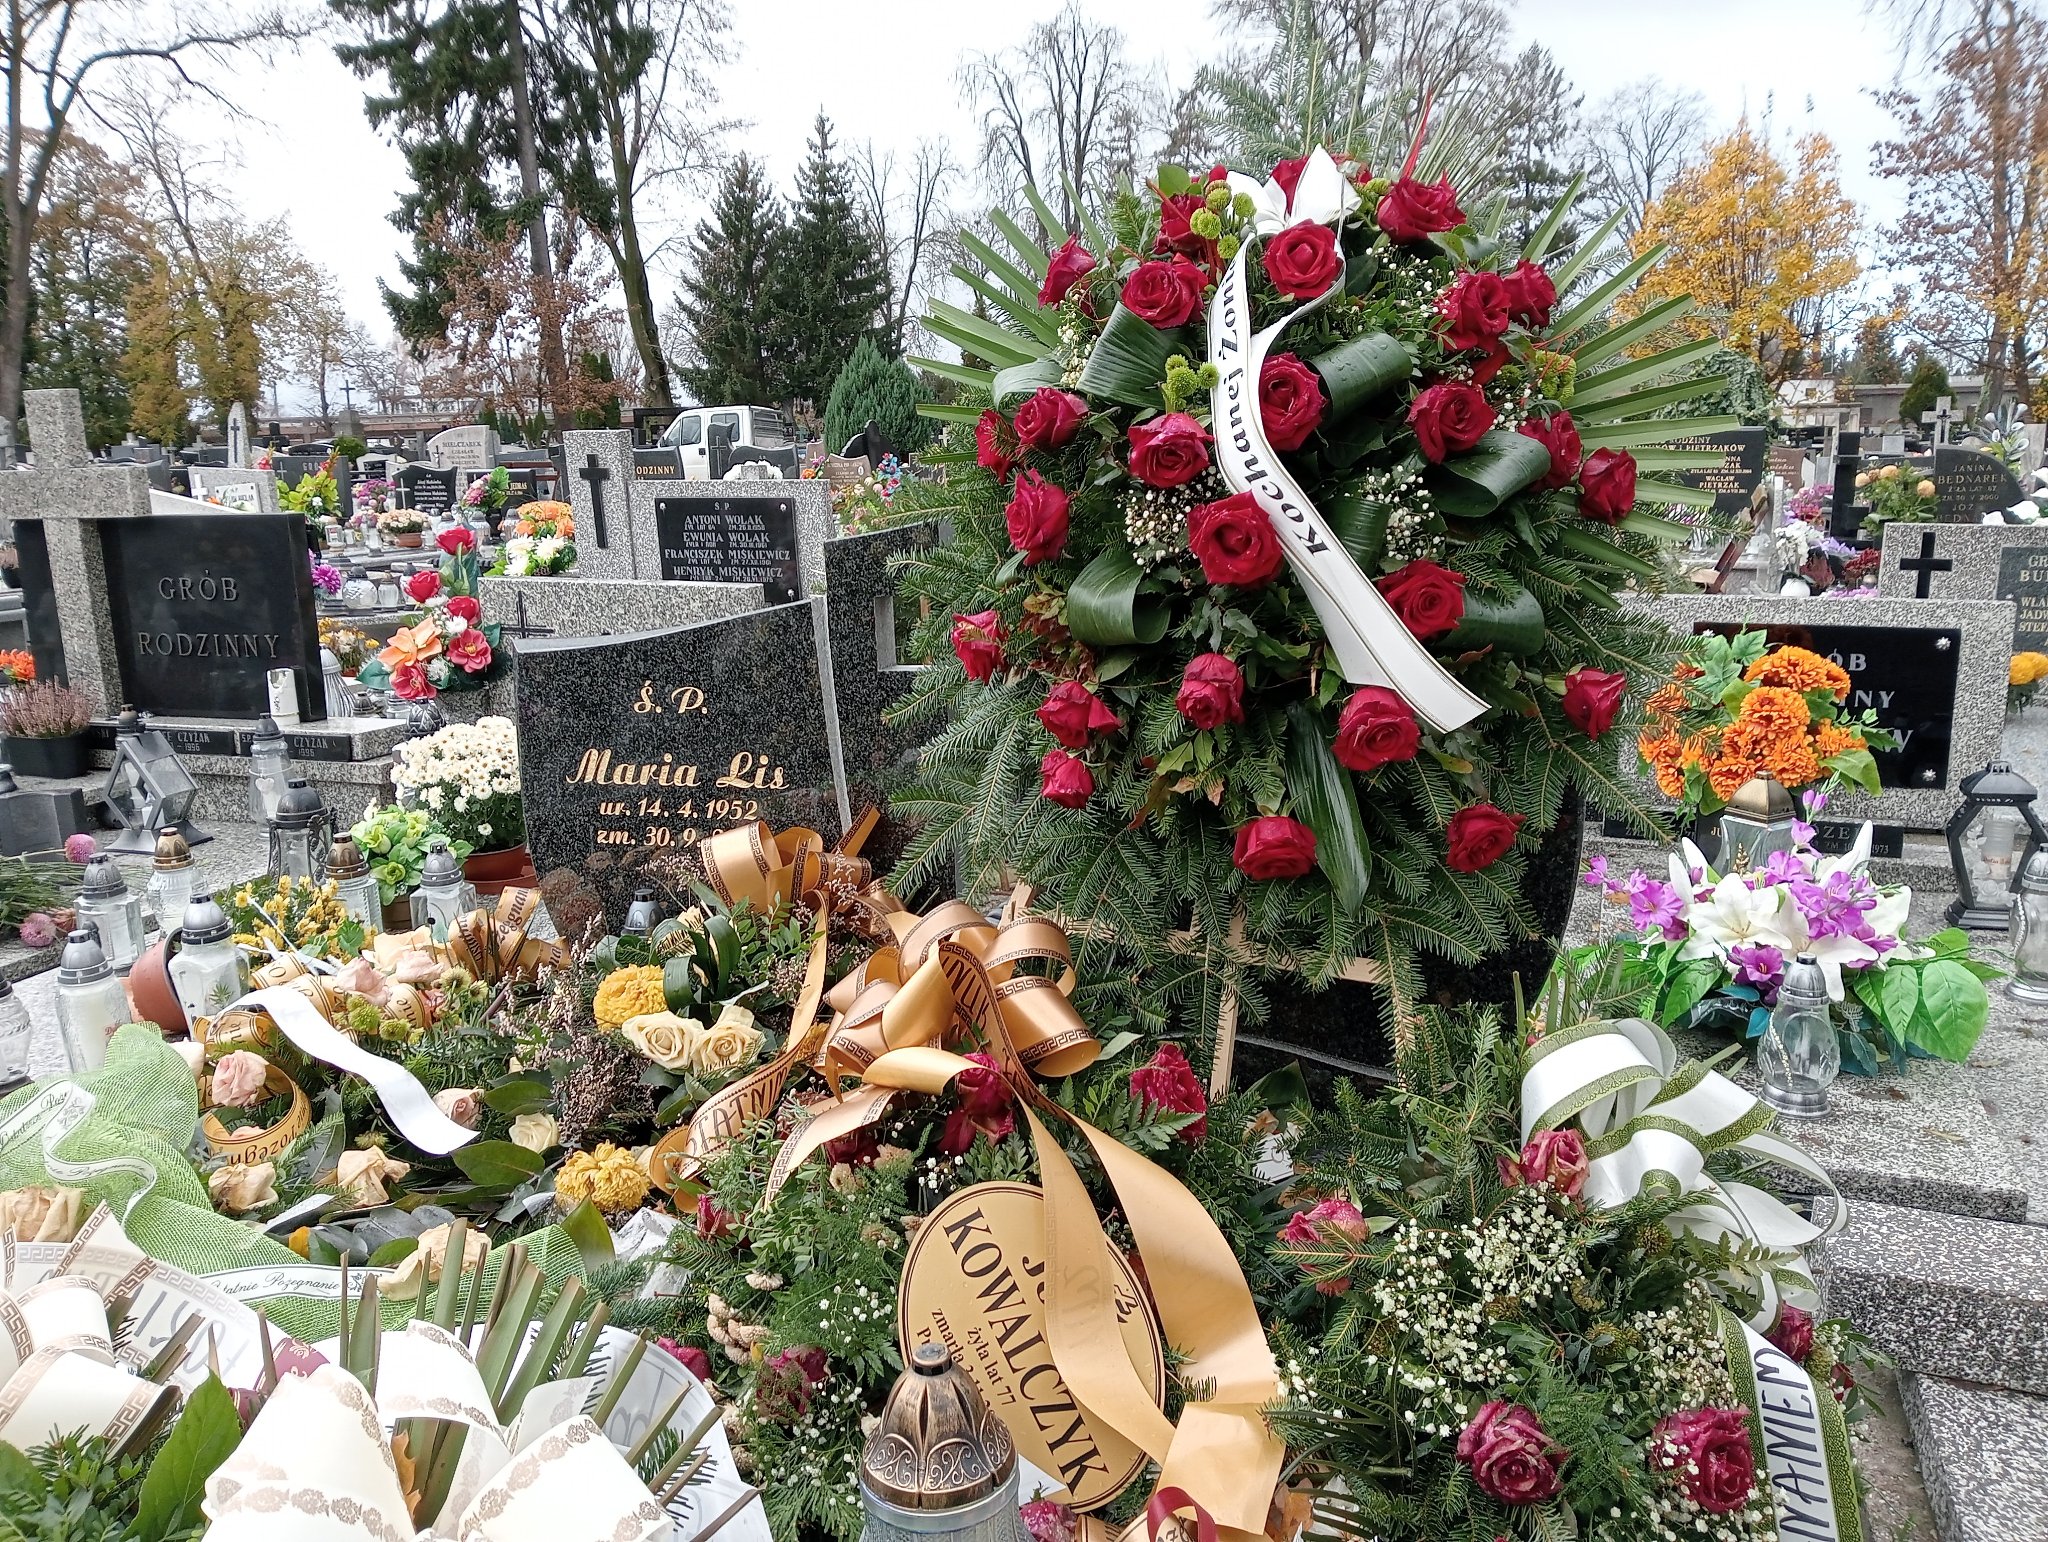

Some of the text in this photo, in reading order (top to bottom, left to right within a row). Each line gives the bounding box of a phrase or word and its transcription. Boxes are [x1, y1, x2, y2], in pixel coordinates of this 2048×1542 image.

[1224, 366, 1332, 557] Kochanej
[1953, 464, 1993, 472] JANINA
[636, 465, 676, 475] ODZINNY
[1699, 481, 1740, 489] PIETRZAK
[1938, 474, 2007, 484] BEDNAREK
[685, 515, 764, 525] ANTONI WOLAK
[683, 532, 771, 543] EWUNIA WOLAK
[665, 548, 792, 561] FRANCISZEK MIŚKIEWICZ
[673, 566, 783, 578] HENRYK MIŚKIEWICZ
[2020, 569, 2048, 582] BU
[158, 569, 238, 601] GRÓB
[137, 632, 279, 659] RODZINNY
[1826, 648, 1867, 671] ÓB
[633, 680, 708, 714] Ś. P.
[178, 731, 211, 743] CZYŻAK
[293, 736, 328, 749] CZYŻAK
[566, 748, 790, 790] Maria Lis
[599, 798, 758, 821] ur. 14. 4. 1952
[597, 829, 636, 846] zm.
[643, 826, 676, 847] 30.
[262, 1271, 341, 1290] Pożegnanie
[942, 1206, 1111, 1496] KOWALCZYK
[967, 1327, 990, 1362] żyła
[984, 1359, 1004, 1387] lat
[996, 1385, 1017, 1406] 77
